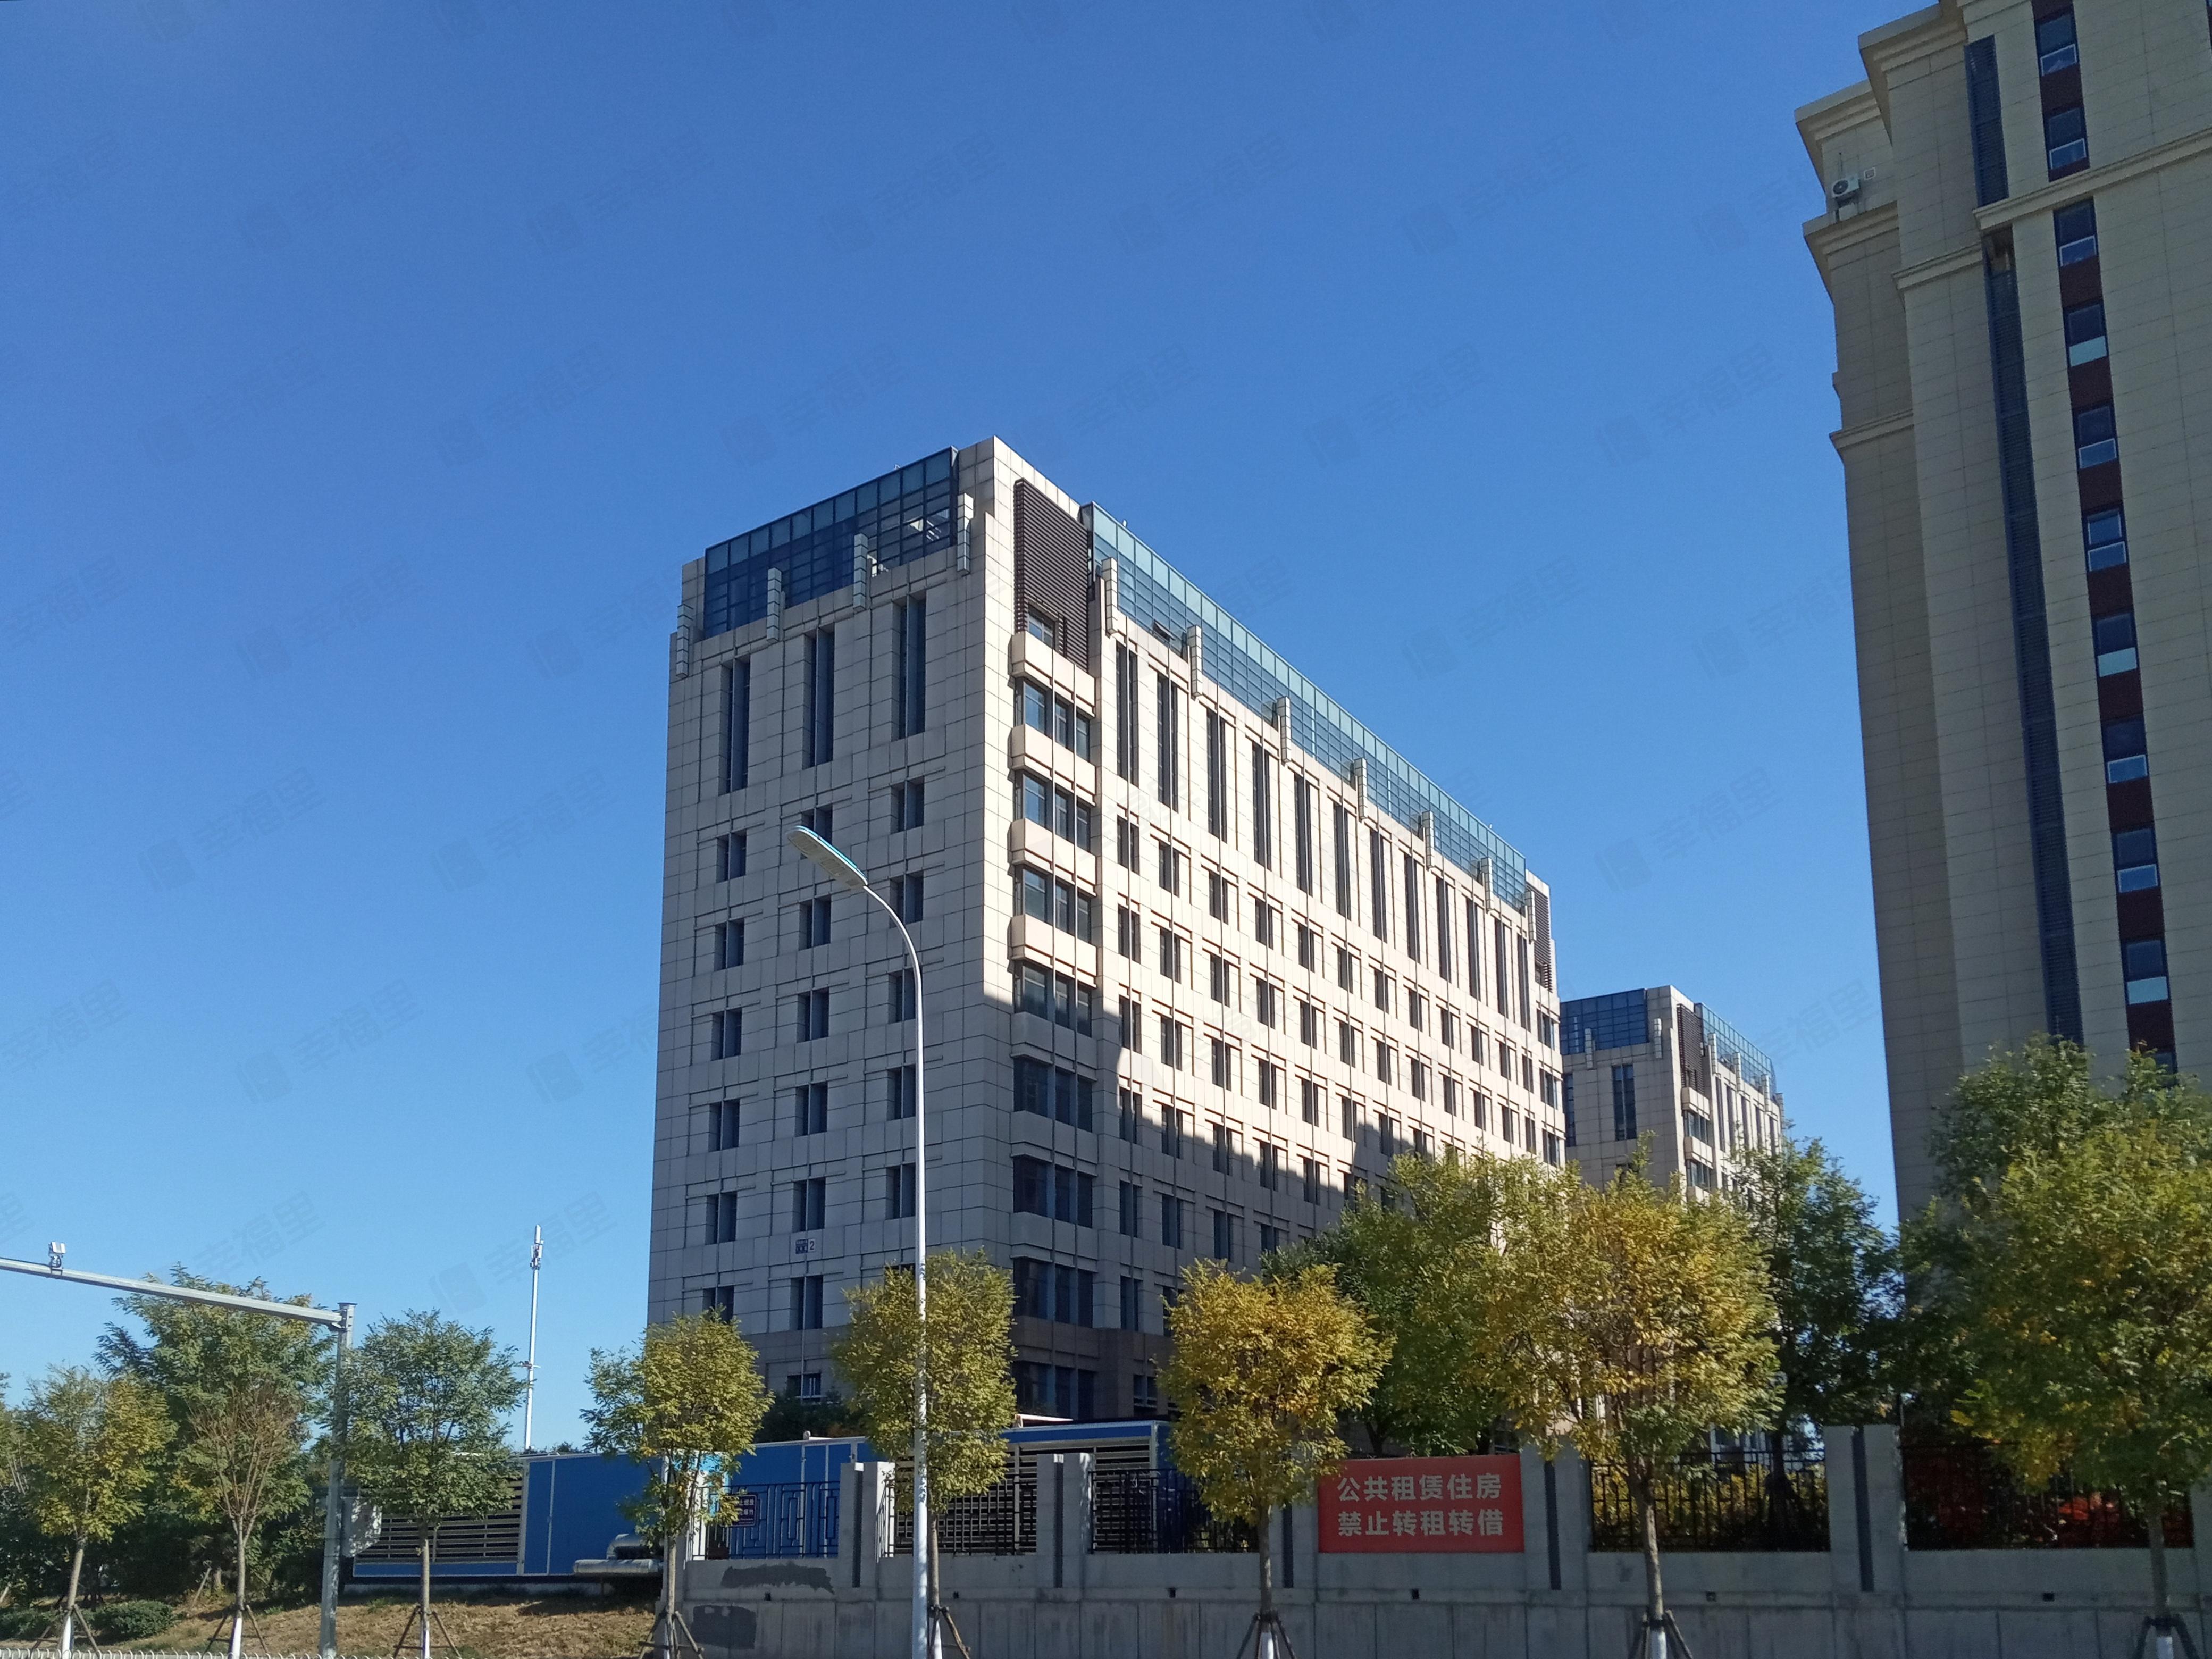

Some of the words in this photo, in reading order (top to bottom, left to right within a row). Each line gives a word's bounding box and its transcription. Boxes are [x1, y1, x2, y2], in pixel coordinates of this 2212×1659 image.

[809, 1241, 815, 1251] 2
[1337, 1472, 1502, 1502] 公共租赁住房
[1338, 1509, 1504, 1537] 禁止转租转借
